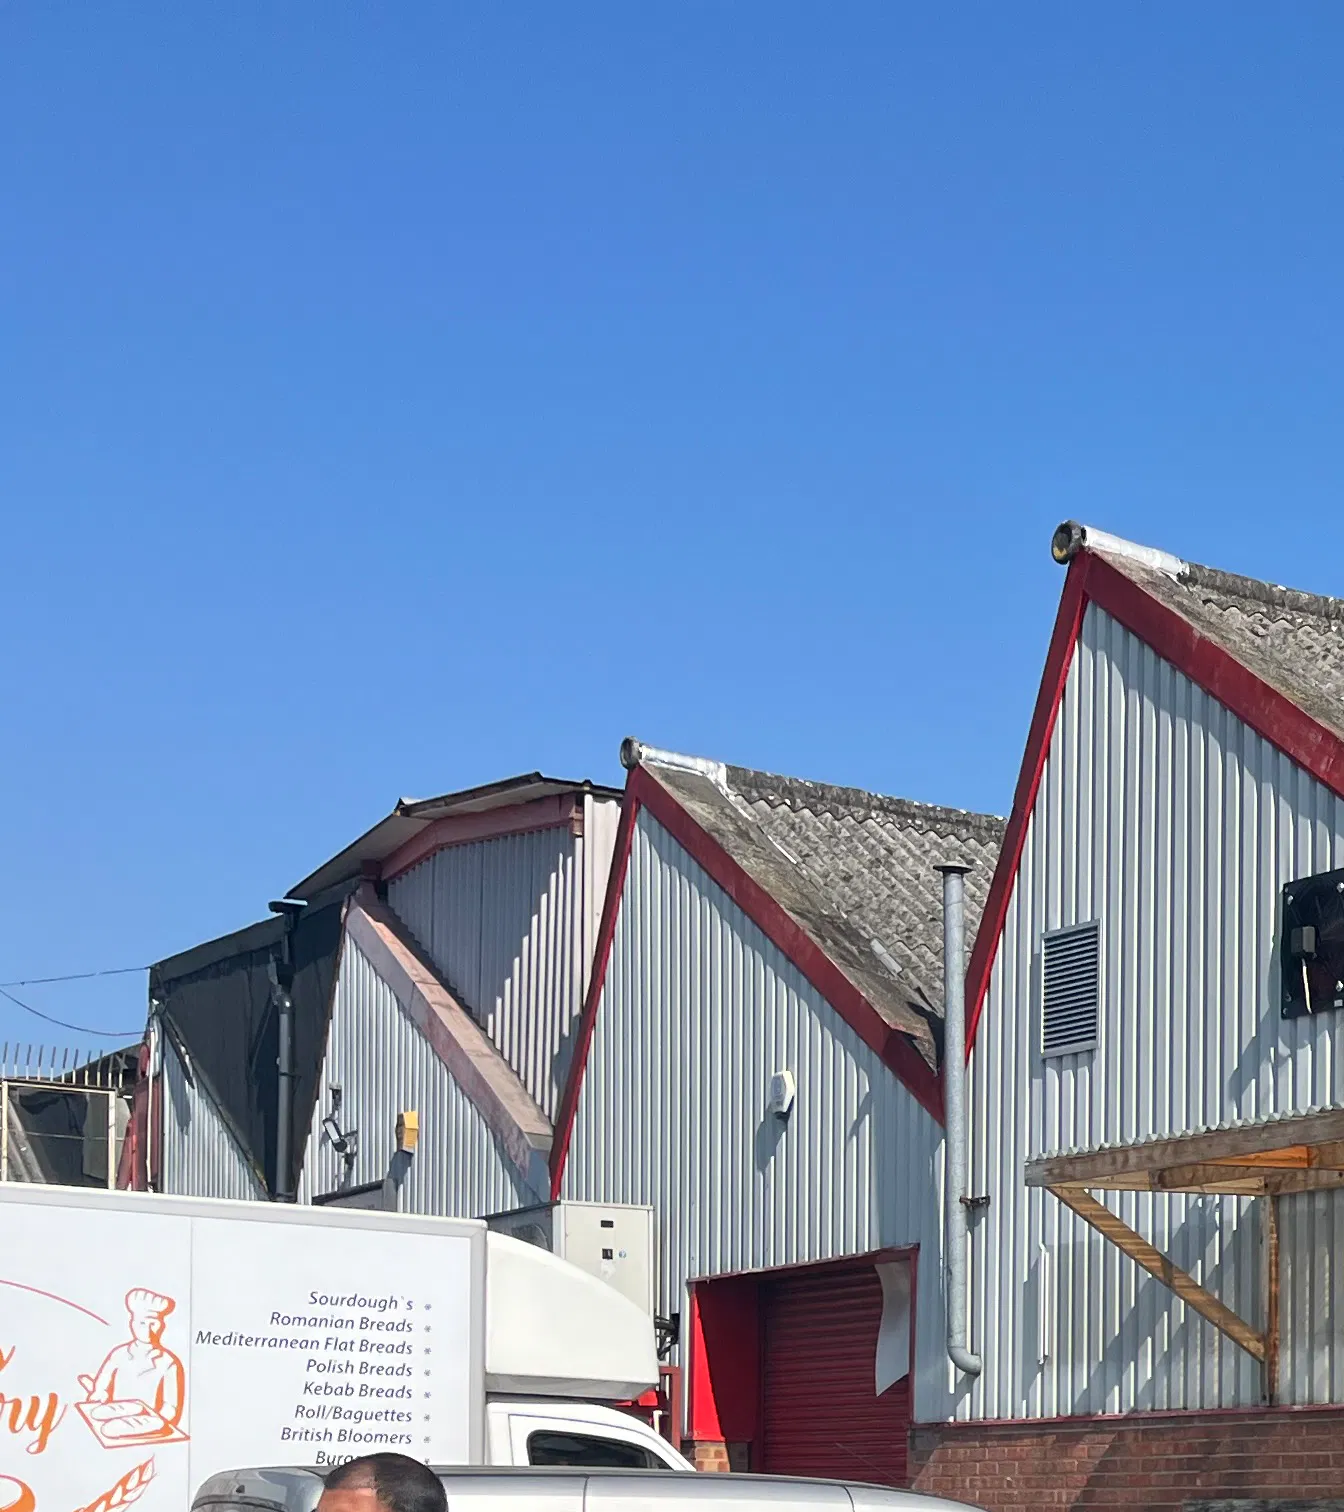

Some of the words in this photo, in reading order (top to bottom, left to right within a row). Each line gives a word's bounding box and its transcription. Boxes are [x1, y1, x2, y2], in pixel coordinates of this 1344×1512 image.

[269, 1311, 355, 1330] Romanian
[359, 1316, 413, 1333] Breads
[195, 1330, 320, 1350] Mediterranean
[324, 1337, 355, 1352] Flat
[359, 1339, 413, 1355] Breads
[306, 1358, 354, 1374] Polish
[359, 1361, 413, 1377] Breads
[303, 1381, 355, 1397] Kebab
[359, 1383, 413, 1399] Breads
[294, 1404, 413, 1424] Roll/Baguettes
[281, 1427, 333, 1442] British
[337, 1428, 412, 1445] Bloomers
